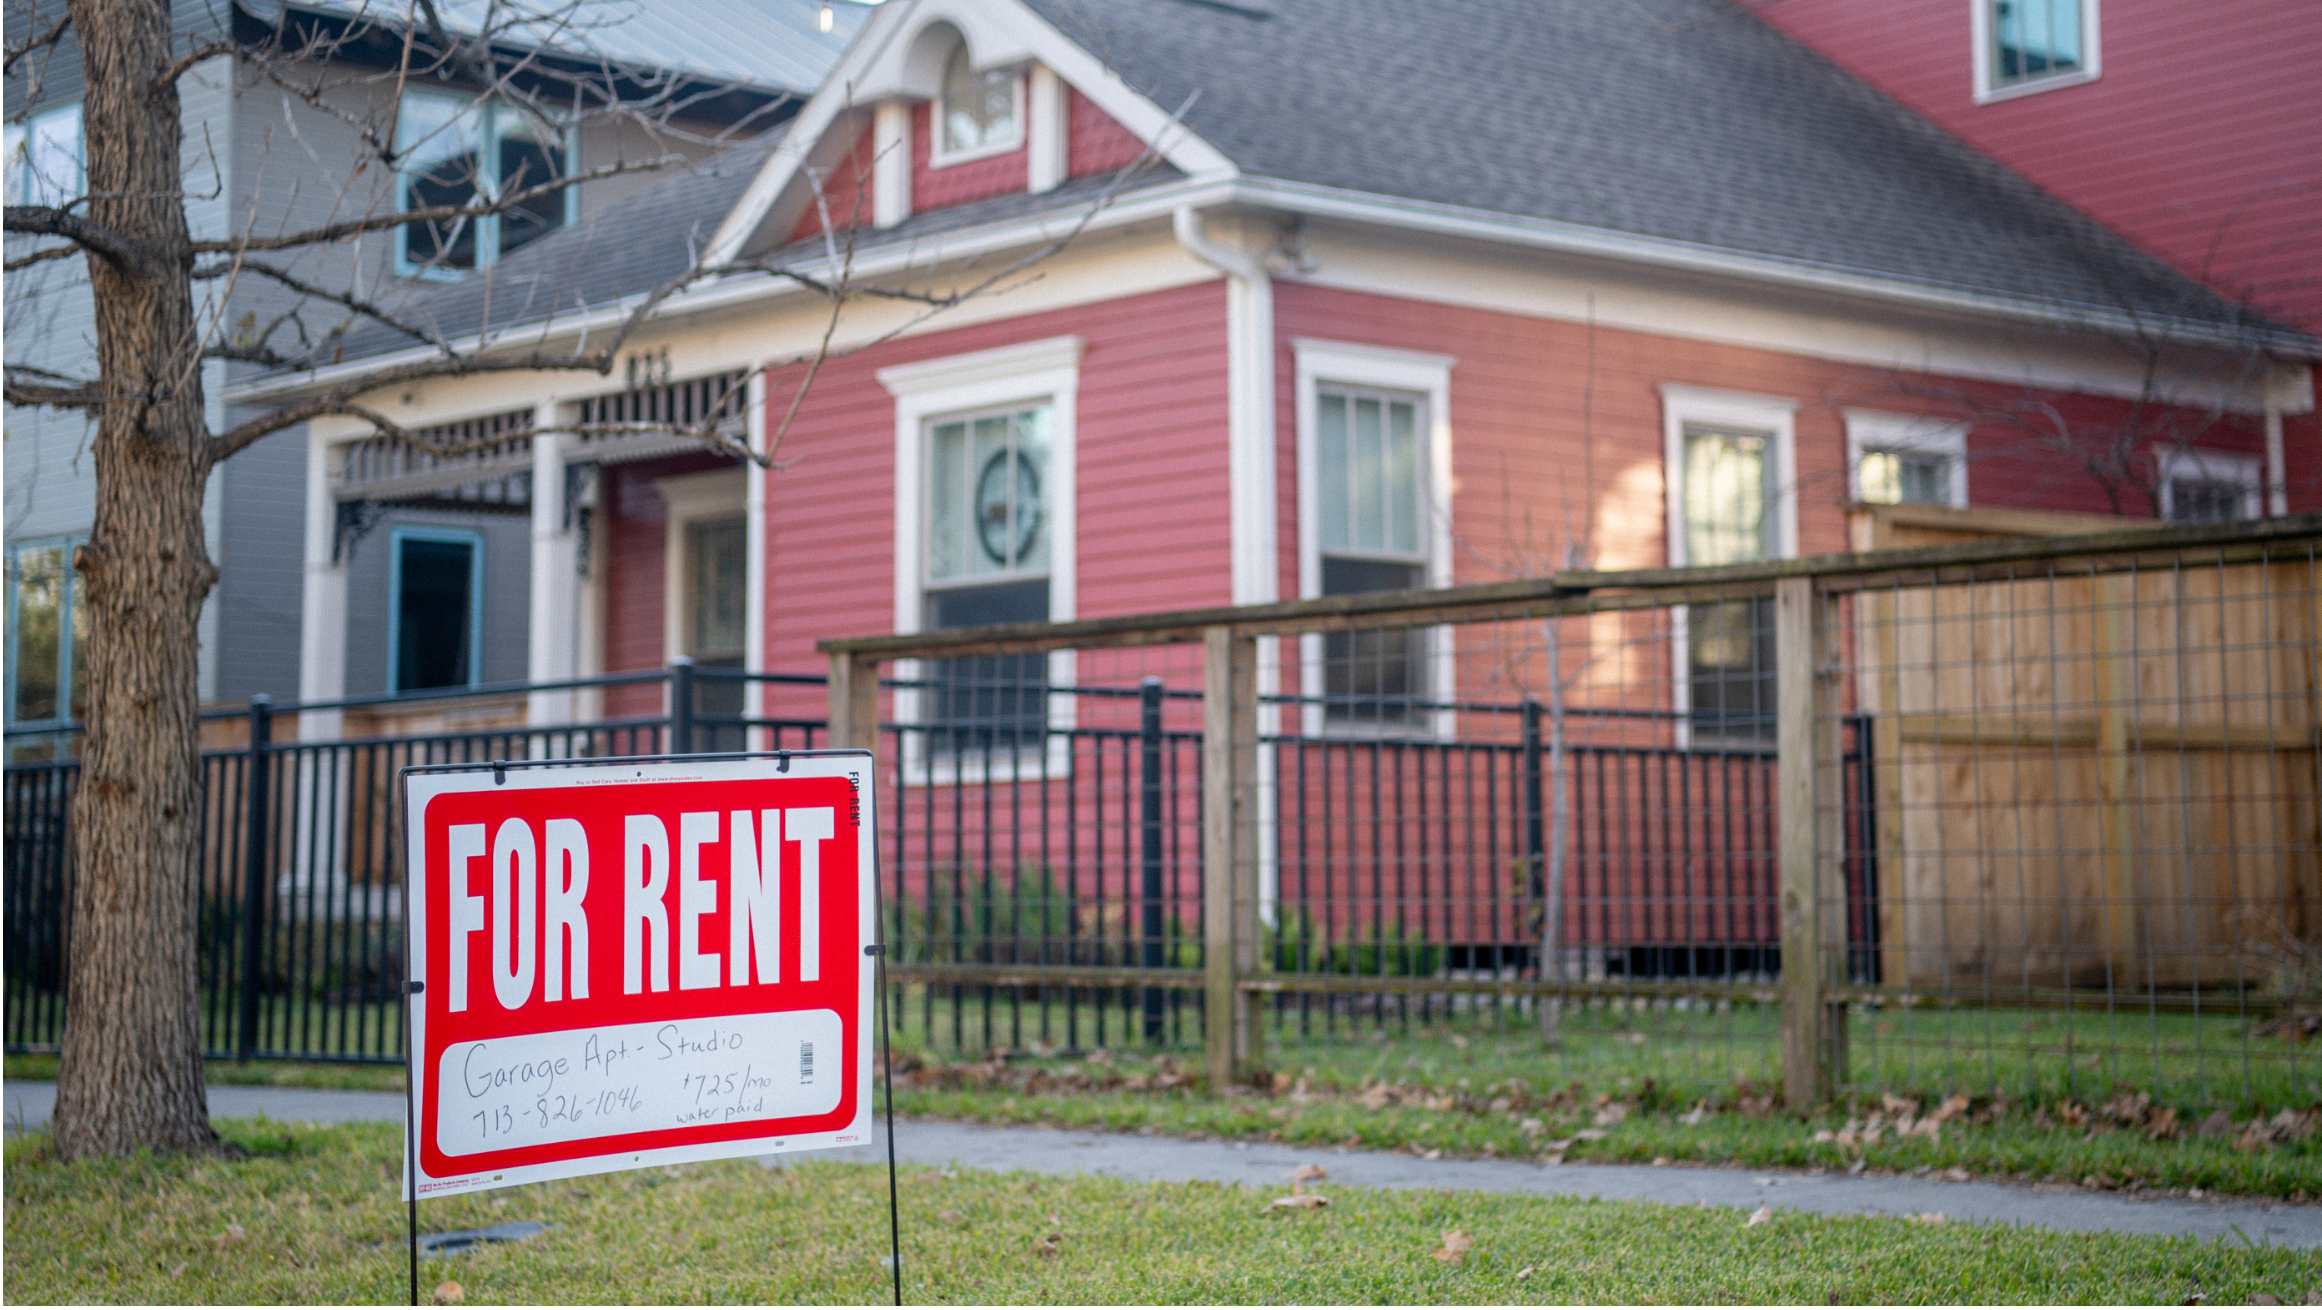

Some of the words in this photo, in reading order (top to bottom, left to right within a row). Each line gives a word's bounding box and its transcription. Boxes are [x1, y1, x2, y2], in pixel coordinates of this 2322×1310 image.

[849, 771, 859, 793] FOR
[849, 797, 861, 827] RENT
[448, 817, 590, 1013] FOR
[623, 806, 835, 996] RENT
[464, 1043, 569, 1098] Garage
[657, 1024, 743, 1061] Studio
[676, 1107, 719, 1124] water
[725, 1096, 763, 1123] paid
